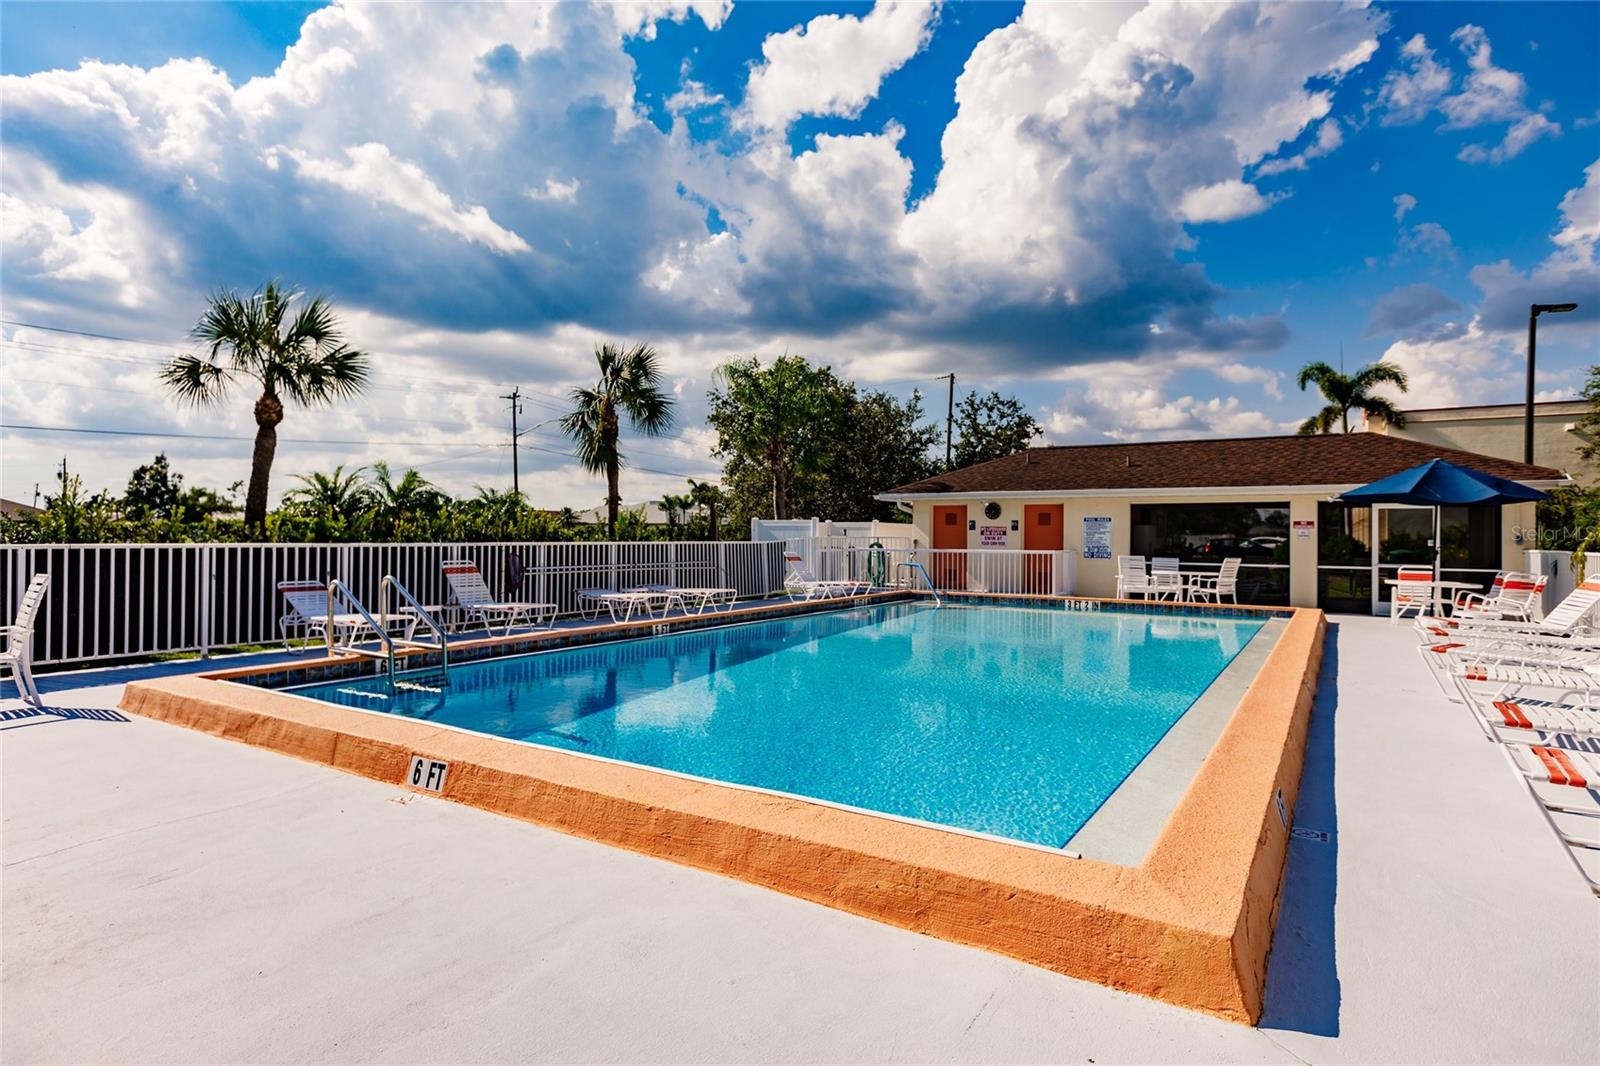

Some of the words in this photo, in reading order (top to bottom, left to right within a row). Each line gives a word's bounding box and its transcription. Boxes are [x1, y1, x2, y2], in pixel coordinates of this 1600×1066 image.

[380, 659, 387, 673] 6
[413, 759, 423, 785] 6
[425, 762, 446, 790] FT
